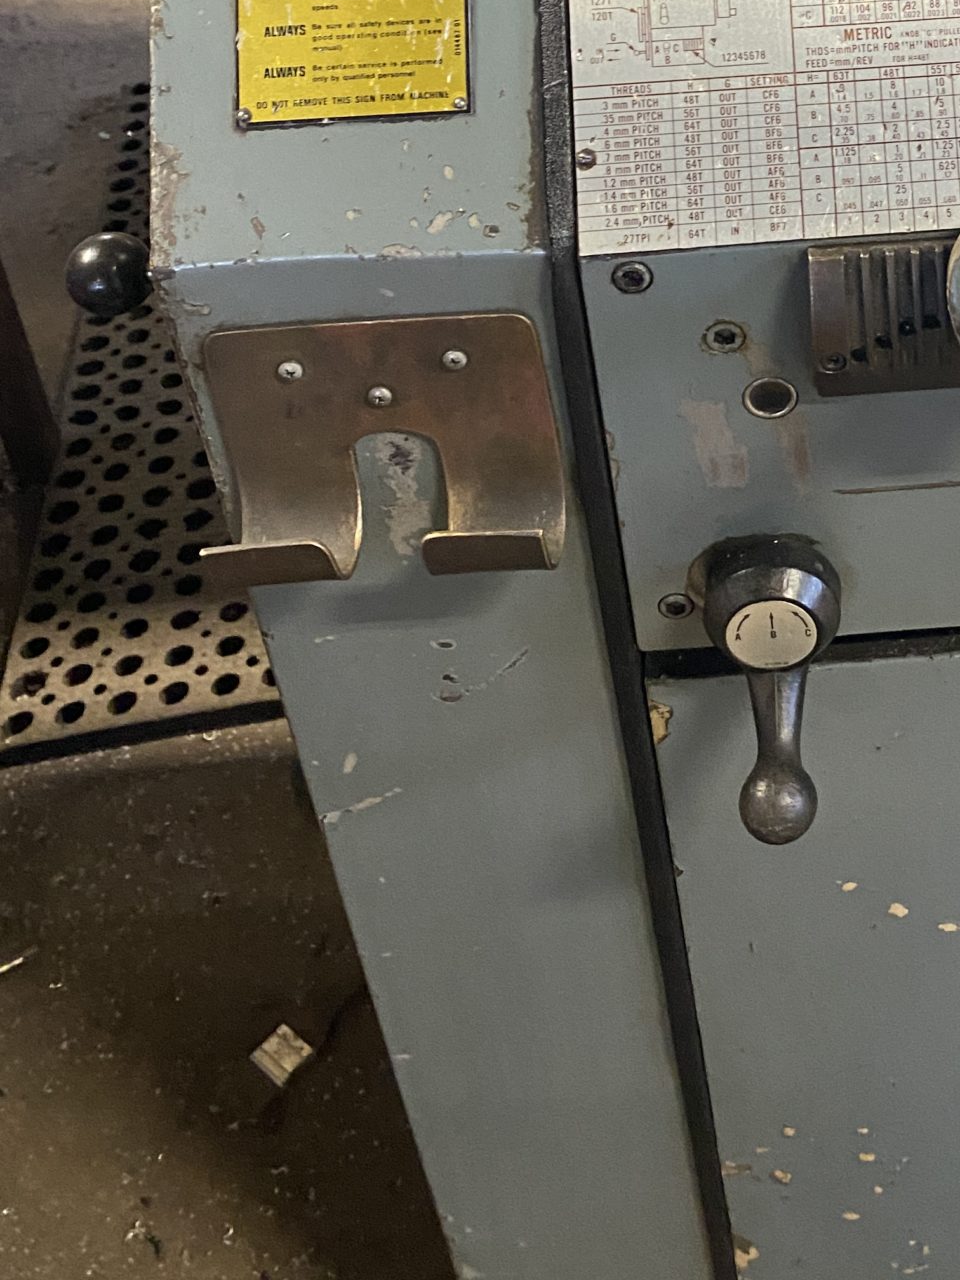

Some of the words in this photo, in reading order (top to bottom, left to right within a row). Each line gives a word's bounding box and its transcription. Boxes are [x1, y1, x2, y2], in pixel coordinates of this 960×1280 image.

[830, 6, 844, 14] 112
[856, 4, 870, 13] 104
[882, 3, 893, 11] 96
[930, 0, 940, 8] 88
[264, 25, 306, 37] ALWAYS
[844, 26, 892, 41] METRIC
[883, 42, 900, 51] FOR
[722, 51, 766, 62] 12345678
[806, 59, 827, 68] FEED
[264, 66, 305, 79] ALWAYS
[833, 72, 849, 81] 63T
[883, 68, 898, 77] 48T
[931, 65, 946, 74] 55T
[611, 85, 652, 95] THREADS
[272, 100, 288, 108] NOT
[293, 98, 327, 107] REMOVE
[333, 97, 351, 105] THIS
[355, 96, 376, 104] SIGN
[381, 94, 404, 102] FROM
[410, 92, 449, 100] MACHINE
[684, 96, 699, 104] 48T
[719, 93, 736, 102] OUT
[763, 91, 779, 99] CF6
[640, 176, 666, 185] PITCH
[689, 230, 705, 239] 64T
[731, 227, 739, 236] IN
